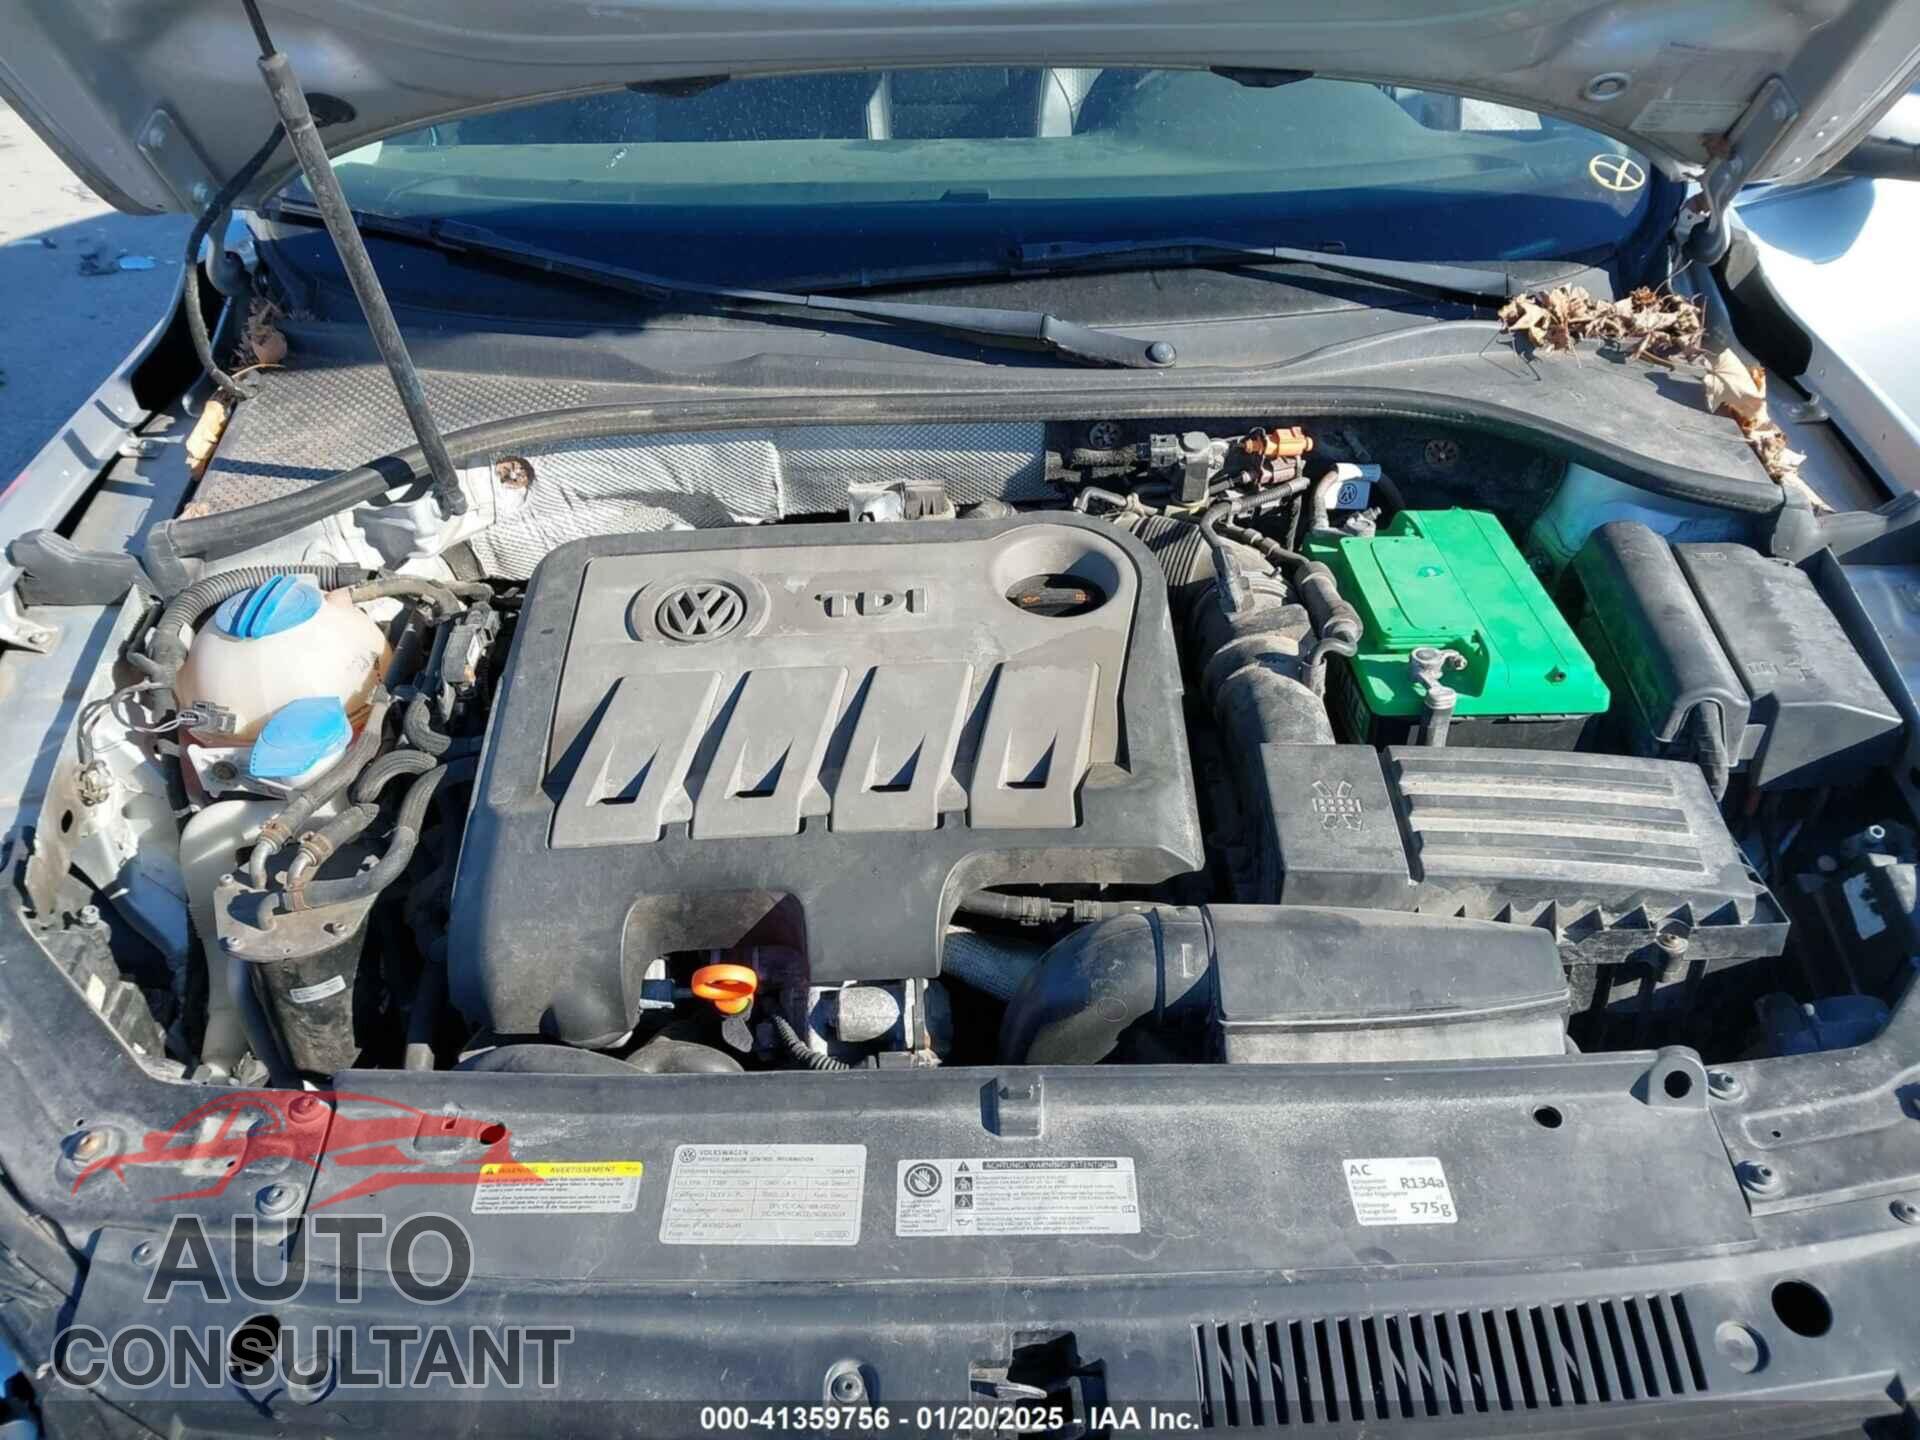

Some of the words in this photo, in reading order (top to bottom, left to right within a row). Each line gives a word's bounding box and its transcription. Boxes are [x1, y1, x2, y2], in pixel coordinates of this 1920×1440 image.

[814, 583, 930, 618] TDI
[1349, 1164, 1372, 1176] AC
[1399, 1176, 1445, 1189] R134a
[1410, 1201, 1452, 1218] 575g
